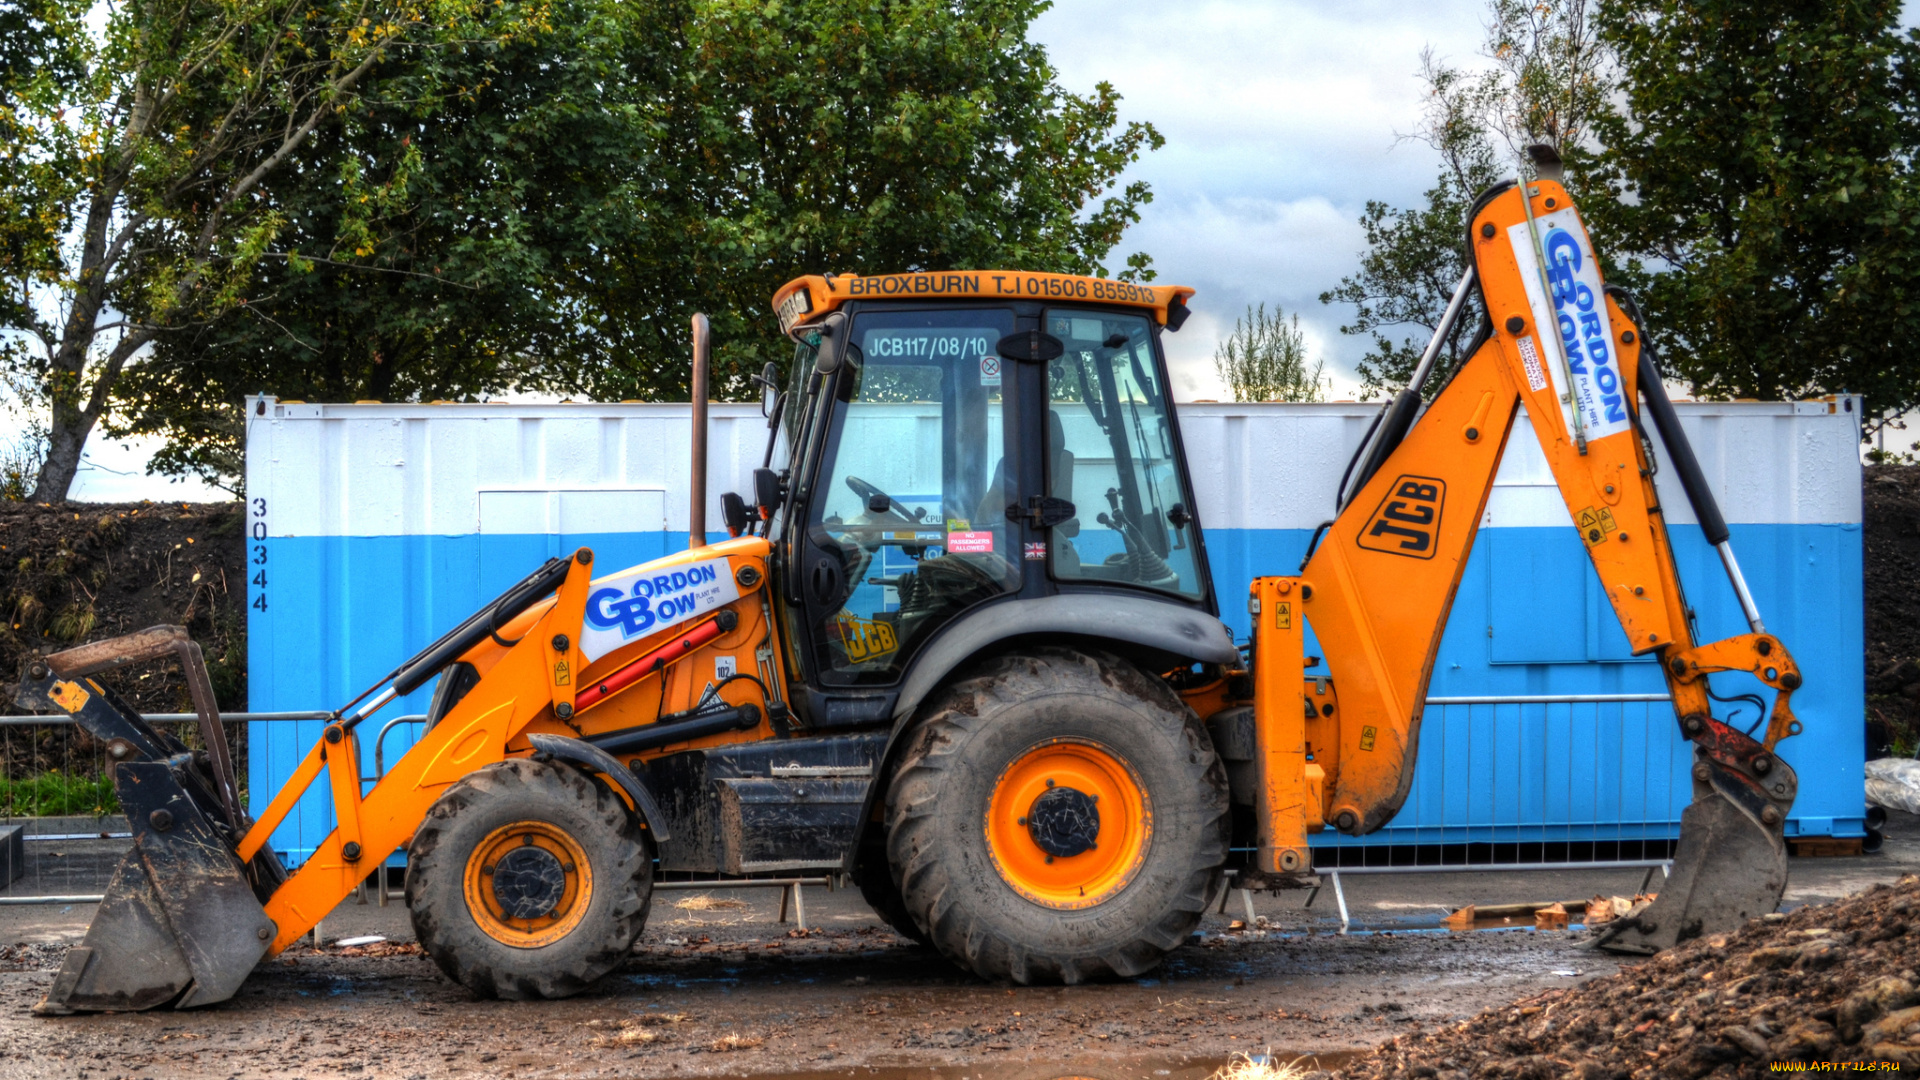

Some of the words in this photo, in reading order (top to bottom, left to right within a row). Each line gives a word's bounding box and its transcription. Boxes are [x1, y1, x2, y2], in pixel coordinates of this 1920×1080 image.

[849, 275, 980, 295] BROXBURN
[1026, 277, 1088, 298] 01506
[1093, 281, 1155, 303] 855913
[1545, 230, 1627, 424] GORDON
[1549, 257, 1588, 376] BOW
[869, 337, 988, 360] JCB117/08/10
[1517, 339, 1529, 364] QUICK
[1526, 365, 1537, 391] HITCH
[1521, 339, 1542, 388] AUTOMATIC
[1528, 339, 1545, 383] TWINLOCK
[1580, 377, 1594, 405] PLANT
[1588, 407, 1600, 428] HIRE
[1369, 481, 1437, 551] JCB
[252, 497, 268, 613] 30344
[584, 564, 717, 631] GORDON
[609, 592, 697, 639] BOW
[695, 590, 710, 600] PLANT
[710, 586, 721, 594] HIRE
[847, 620, 895, 658] JCB
[717, 666, 730, 678] 102
